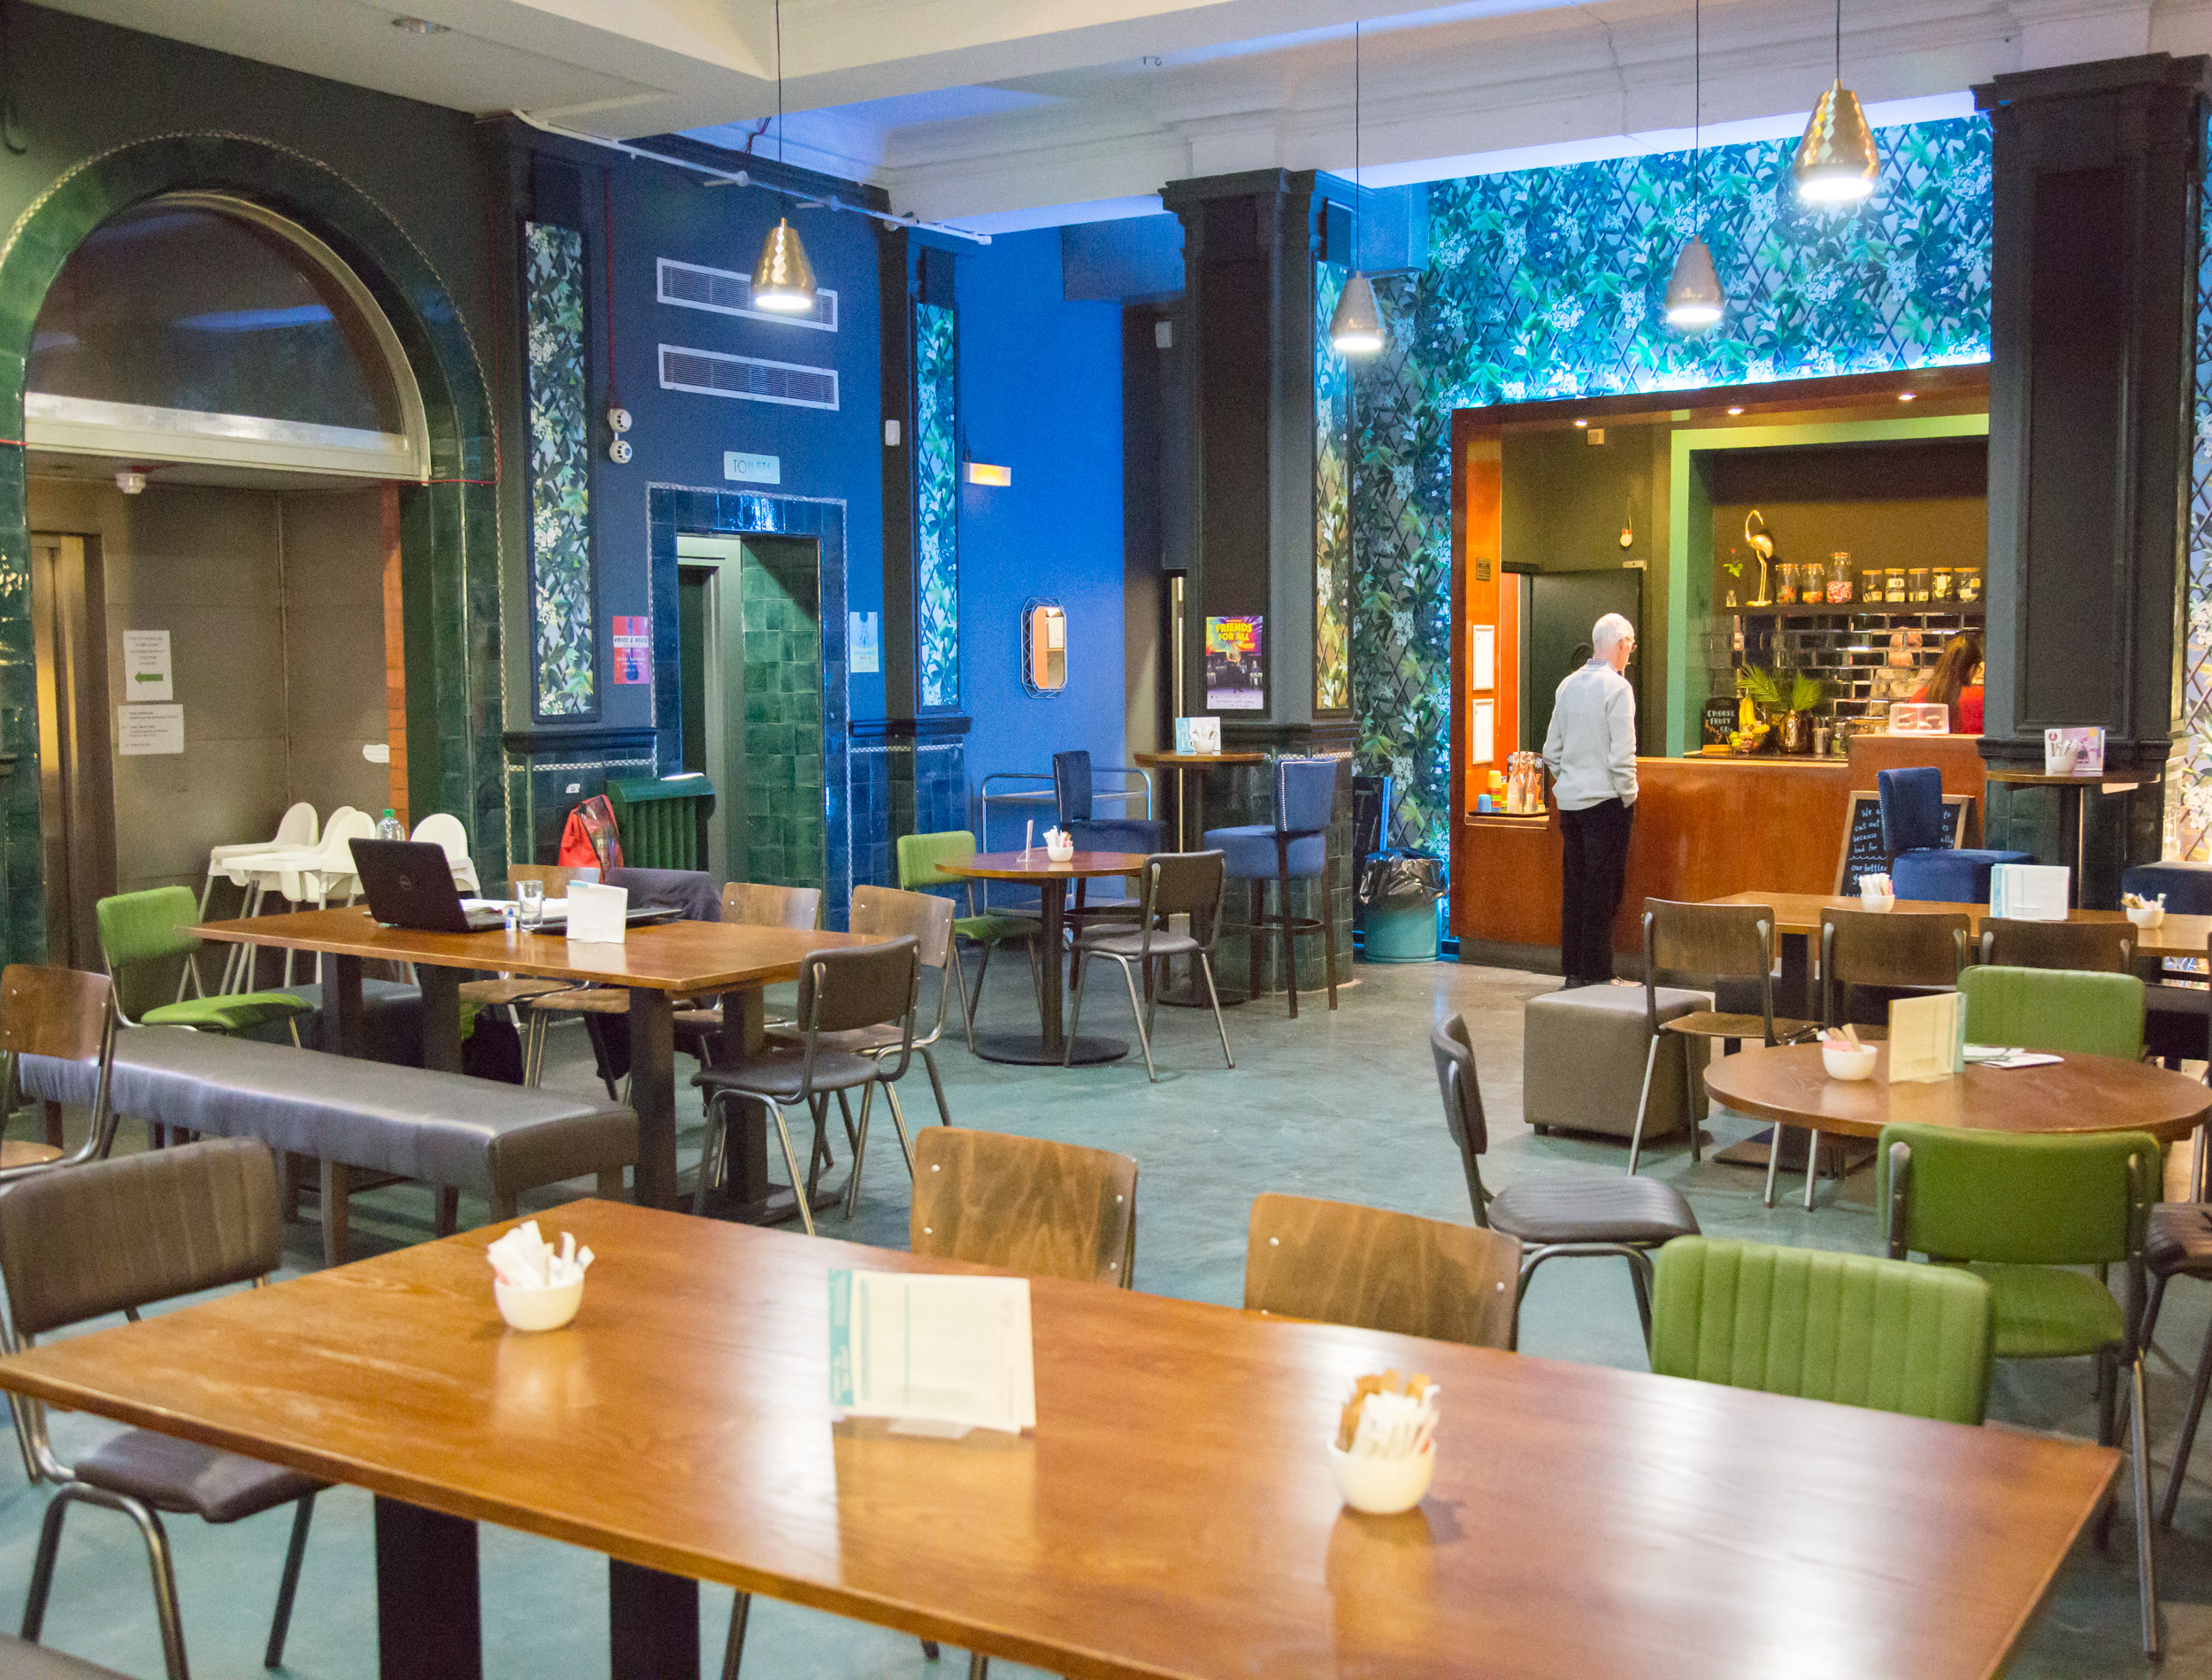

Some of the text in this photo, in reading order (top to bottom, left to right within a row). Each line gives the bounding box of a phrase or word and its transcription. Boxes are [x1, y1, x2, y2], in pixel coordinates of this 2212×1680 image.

[733, 459, 772, 476] TOILETS
[1216, 623, 1253, 633] FRIENDS
[1218, 632, 1250, 641] FOR ALL
[1862, 807, 1872, 817] We
[1943, 809, 1951, 819] to
[1855, 818, 1880, 832] cut out
[1853, 832, 1878, 842] because
[1854, 842, 1878, 854] bad for
